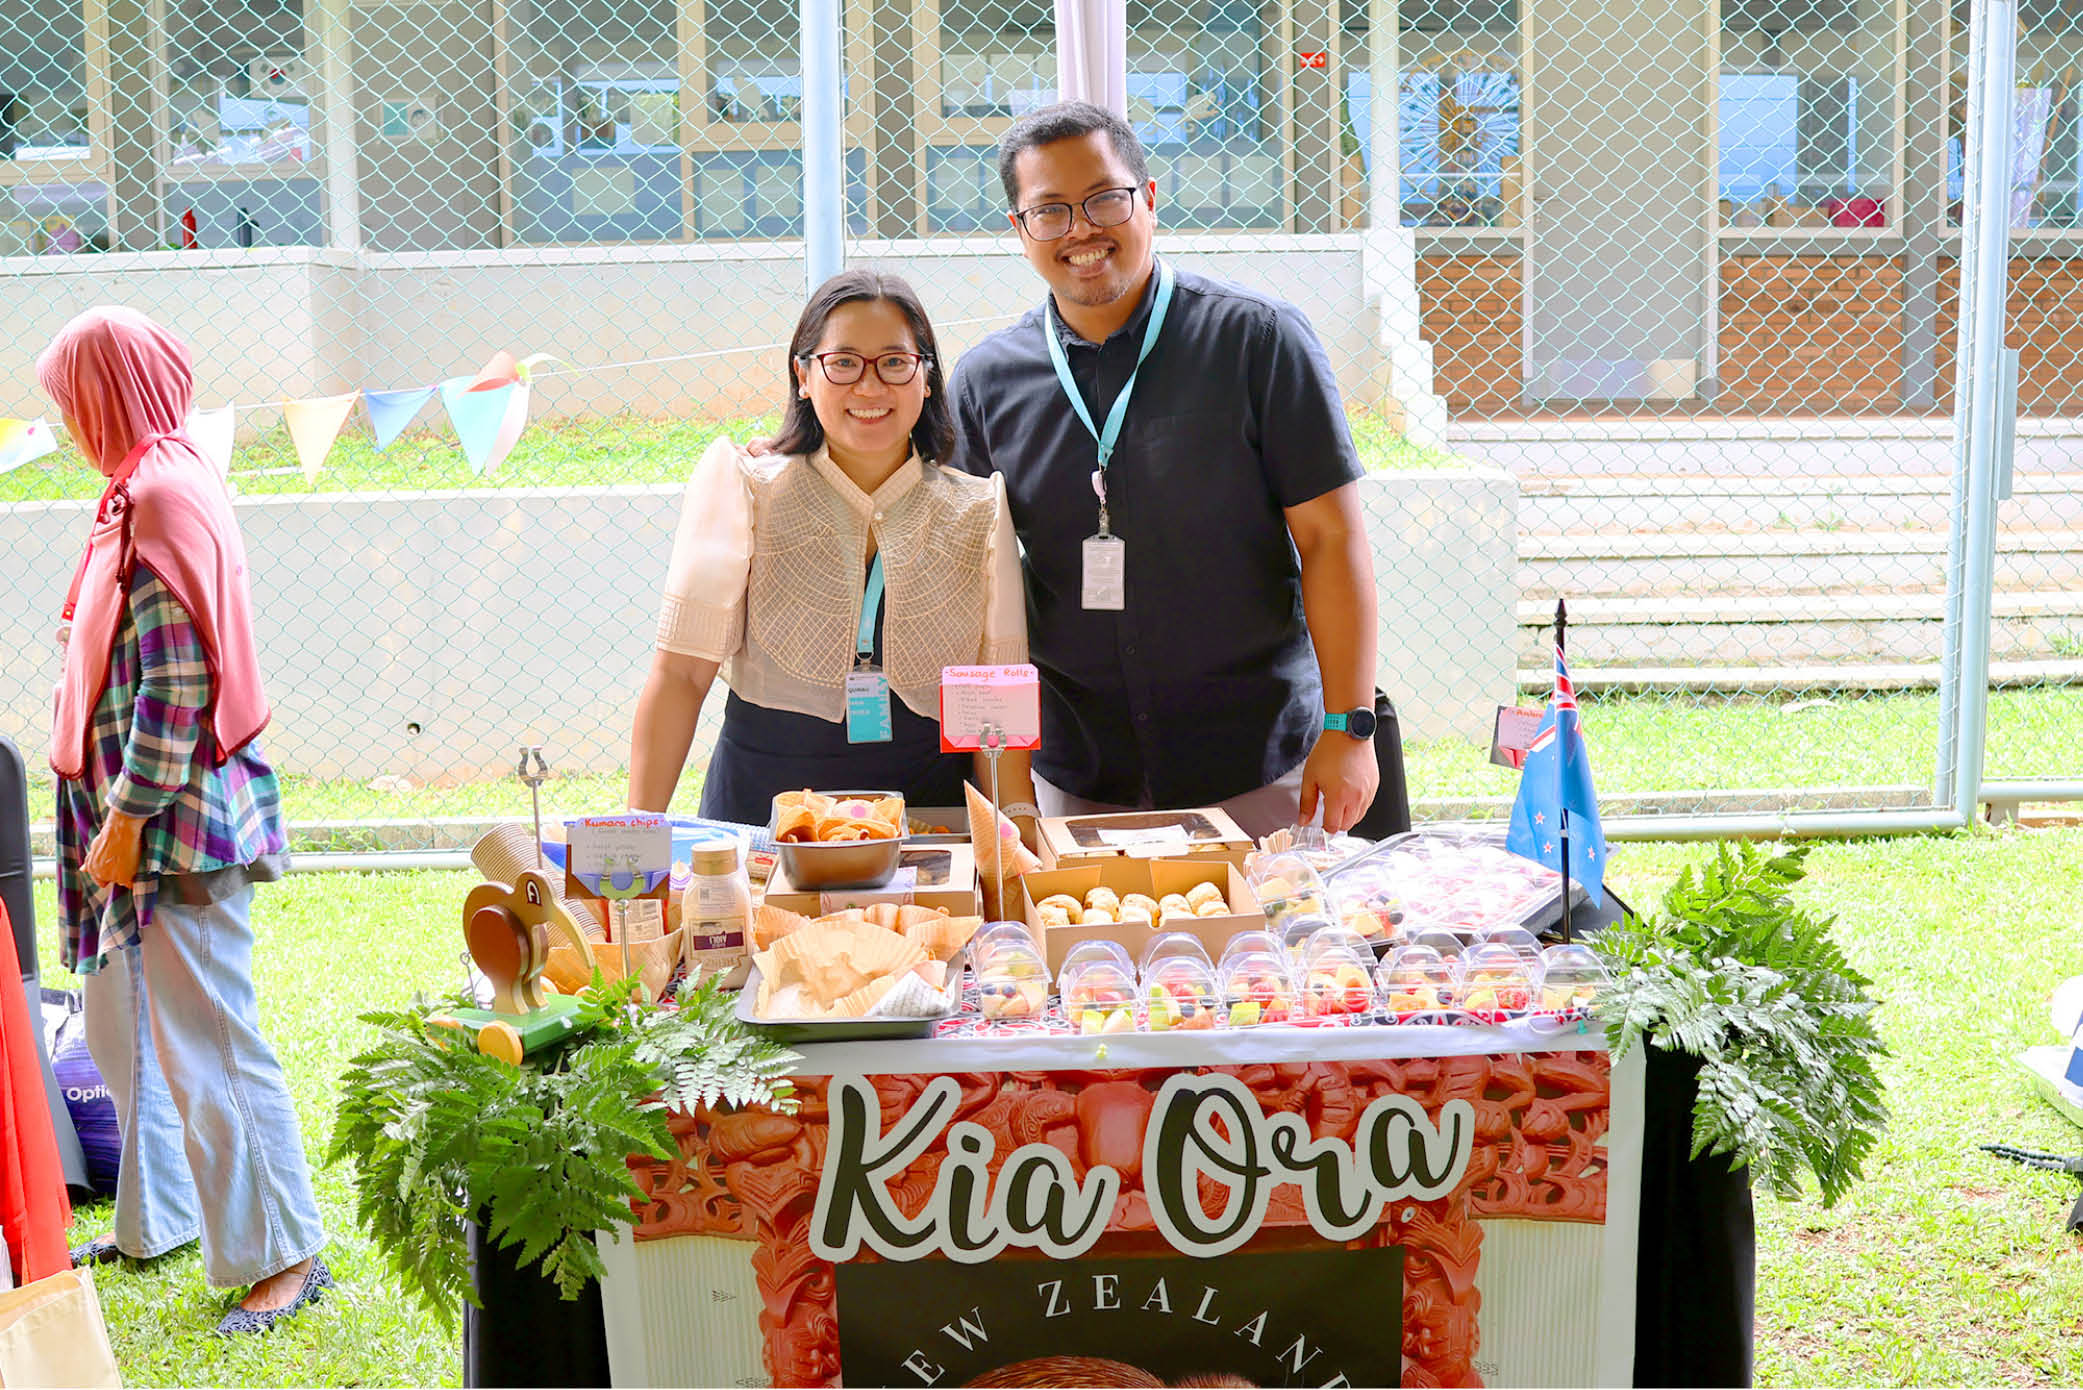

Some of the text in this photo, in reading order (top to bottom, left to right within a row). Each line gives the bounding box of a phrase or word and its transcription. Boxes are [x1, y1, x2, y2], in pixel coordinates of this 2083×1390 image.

[877, 675, 891, 738] FAMILY
[948, 667, 1029, 681] Sausage Rolls
[822, 1083, 1461, 1252] Kia Ora
[882, 1306, 991, 1388] EW
